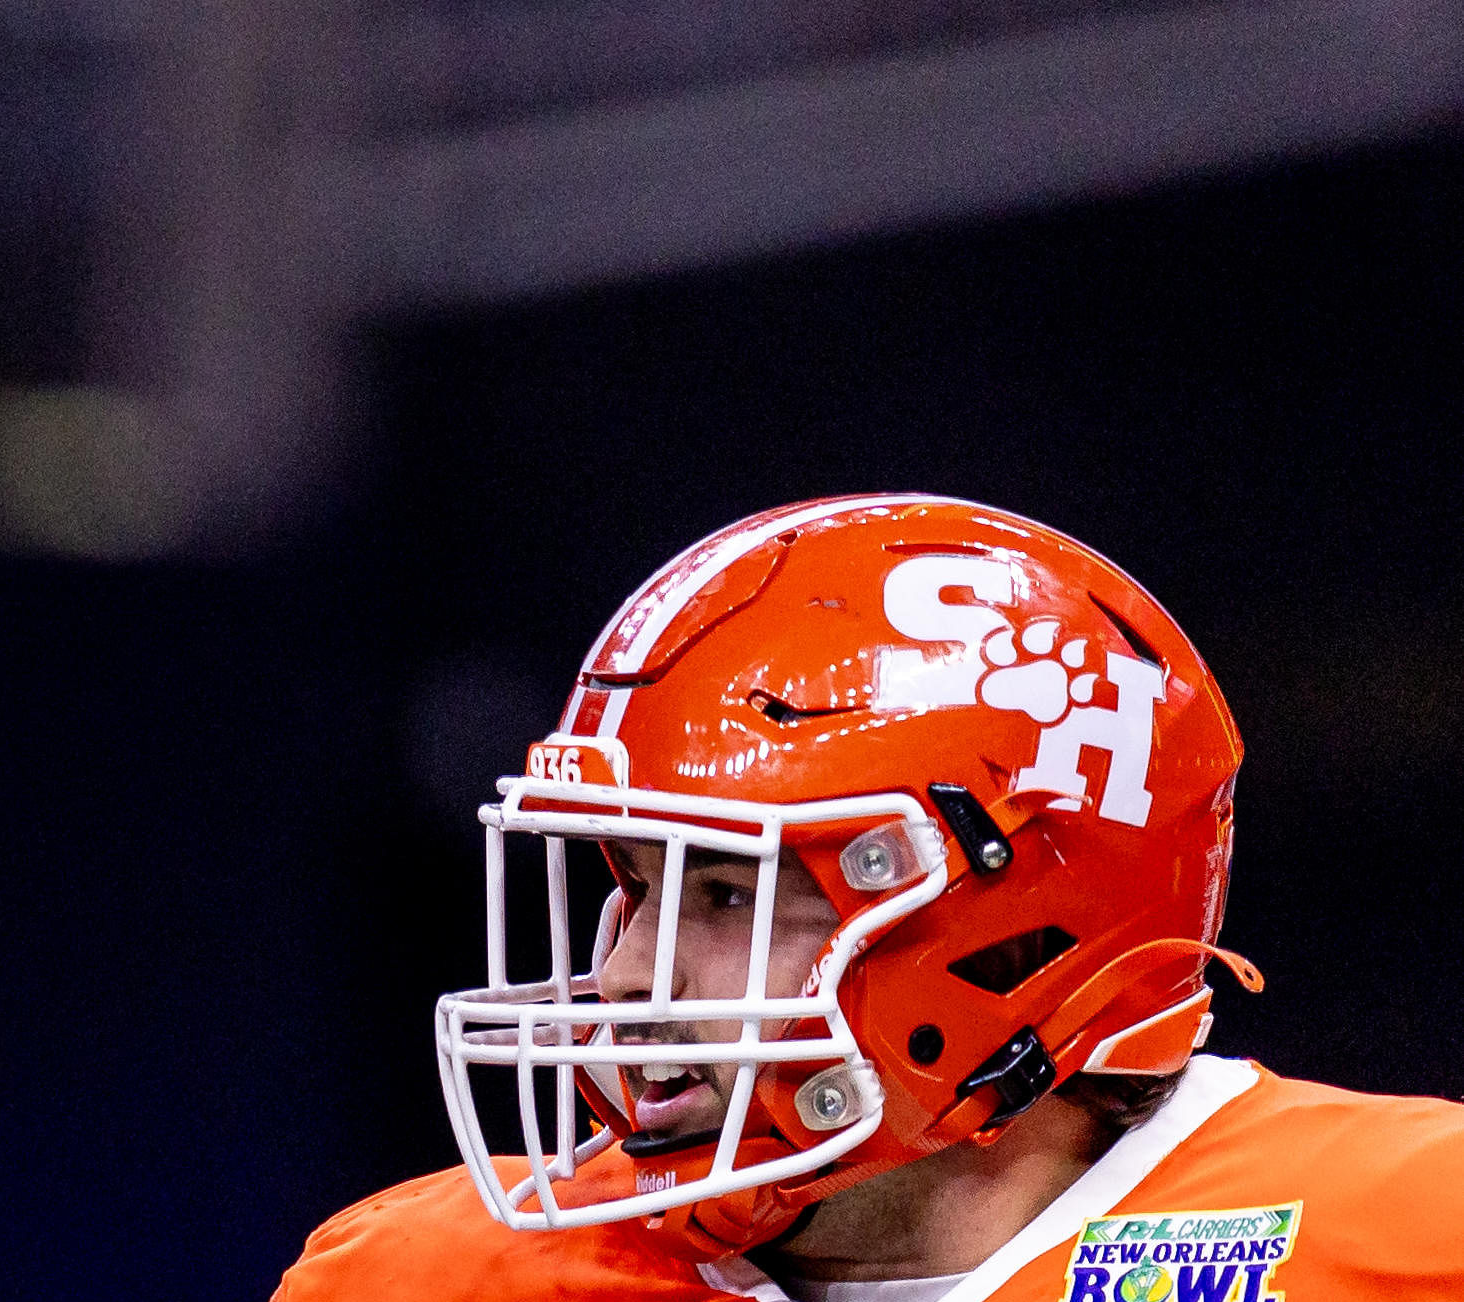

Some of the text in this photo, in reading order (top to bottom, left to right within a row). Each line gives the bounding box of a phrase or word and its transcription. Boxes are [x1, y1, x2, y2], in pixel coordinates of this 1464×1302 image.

[1177, 1216, 1263, 1240] CARRIERS
[1075, 1237, 1287, 1265] NEW ORLEANS
